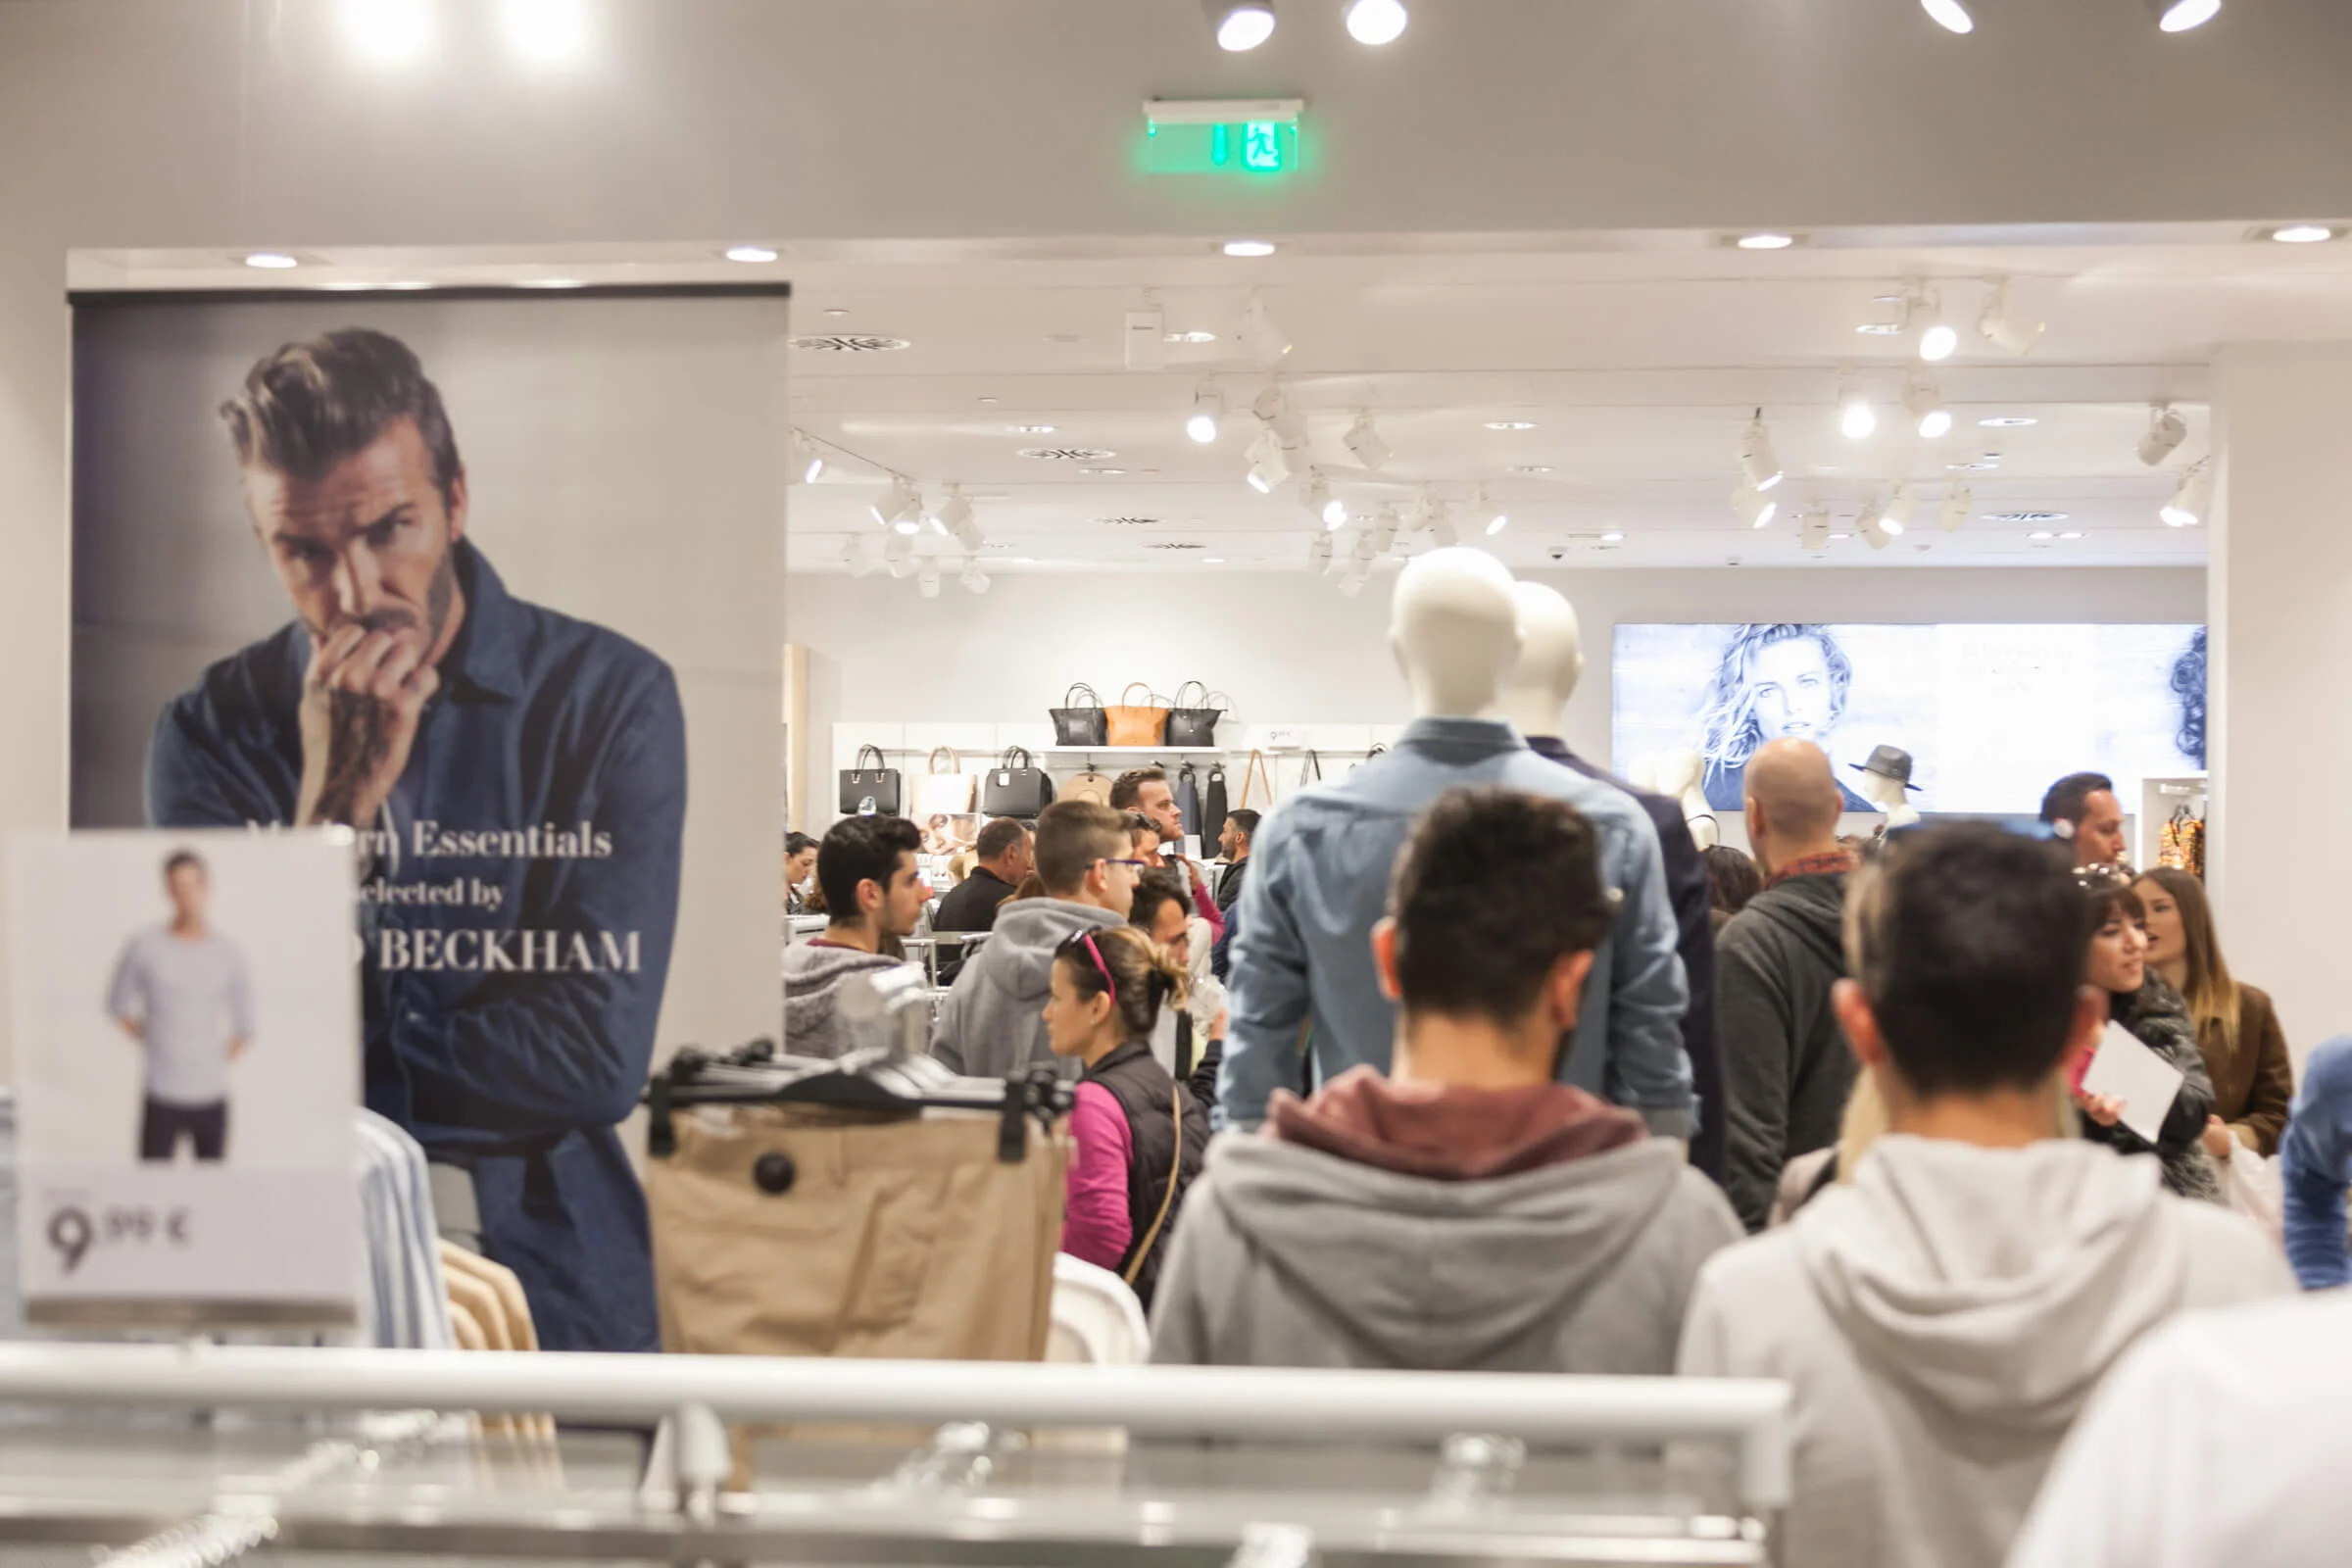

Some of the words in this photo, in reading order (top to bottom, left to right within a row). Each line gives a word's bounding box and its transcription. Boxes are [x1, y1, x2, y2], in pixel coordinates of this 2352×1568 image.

[413, 819, 613, 858] Essentials
[471, 877, 505, 911] by
[378, 928, 643, 972] BECKHAM
